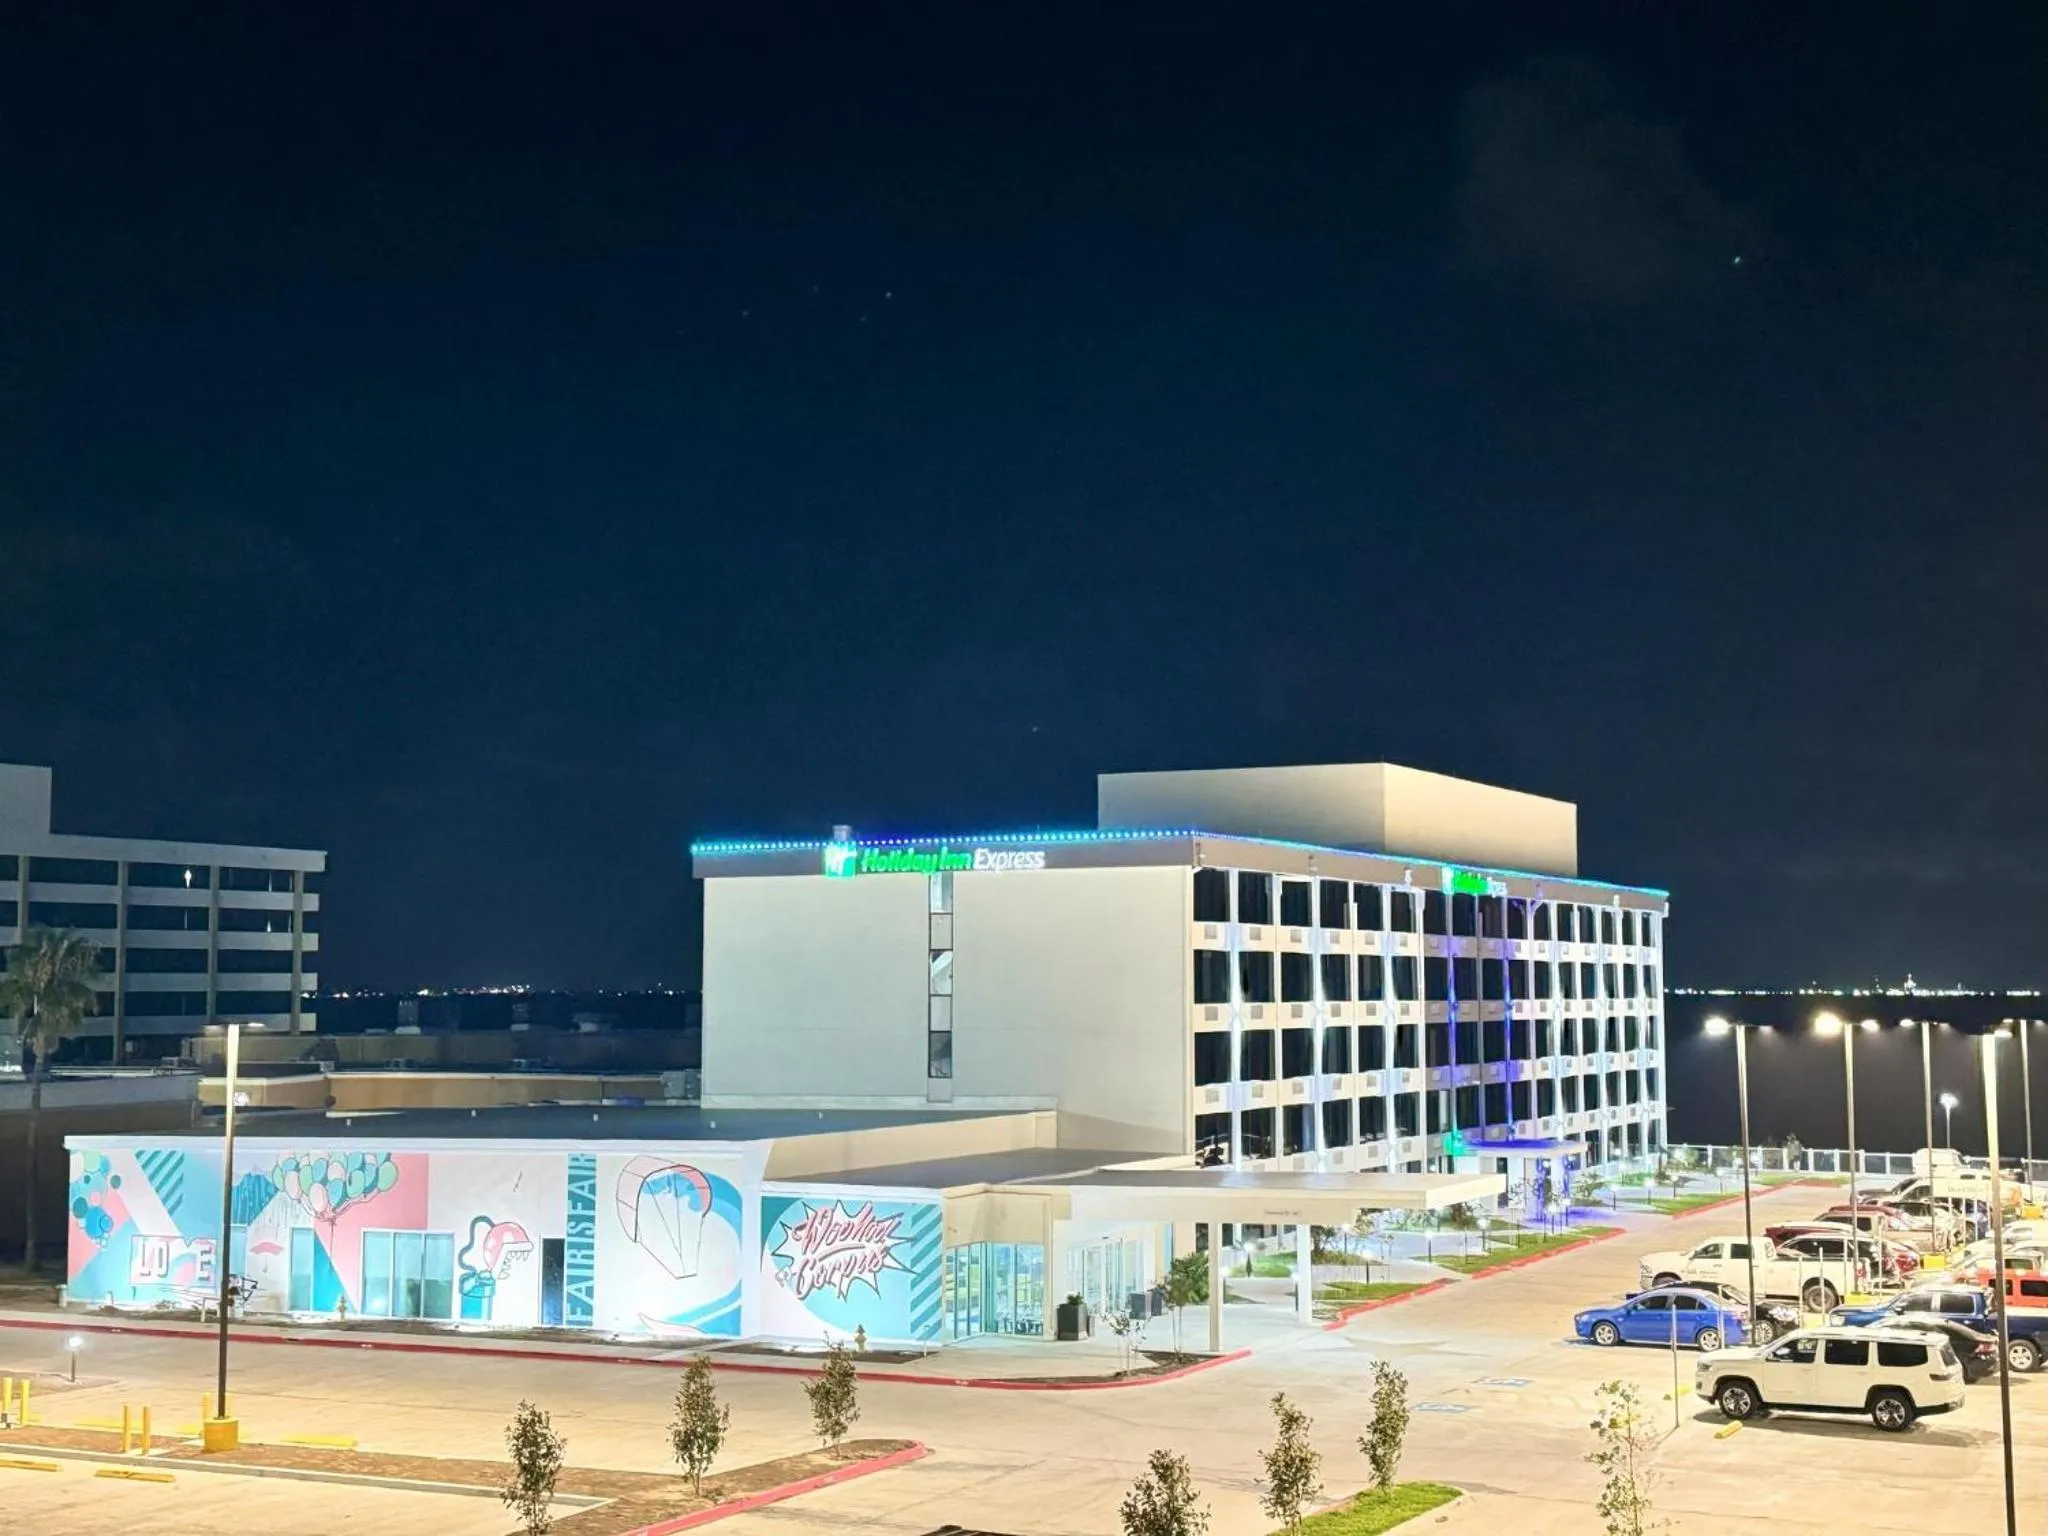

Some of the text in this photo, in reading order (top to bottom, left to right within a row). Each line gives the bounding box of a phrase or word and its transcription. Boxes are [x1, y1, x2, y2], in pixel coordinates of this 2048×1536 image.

[861, 846, 1046, 876] Holiday Inn Express
